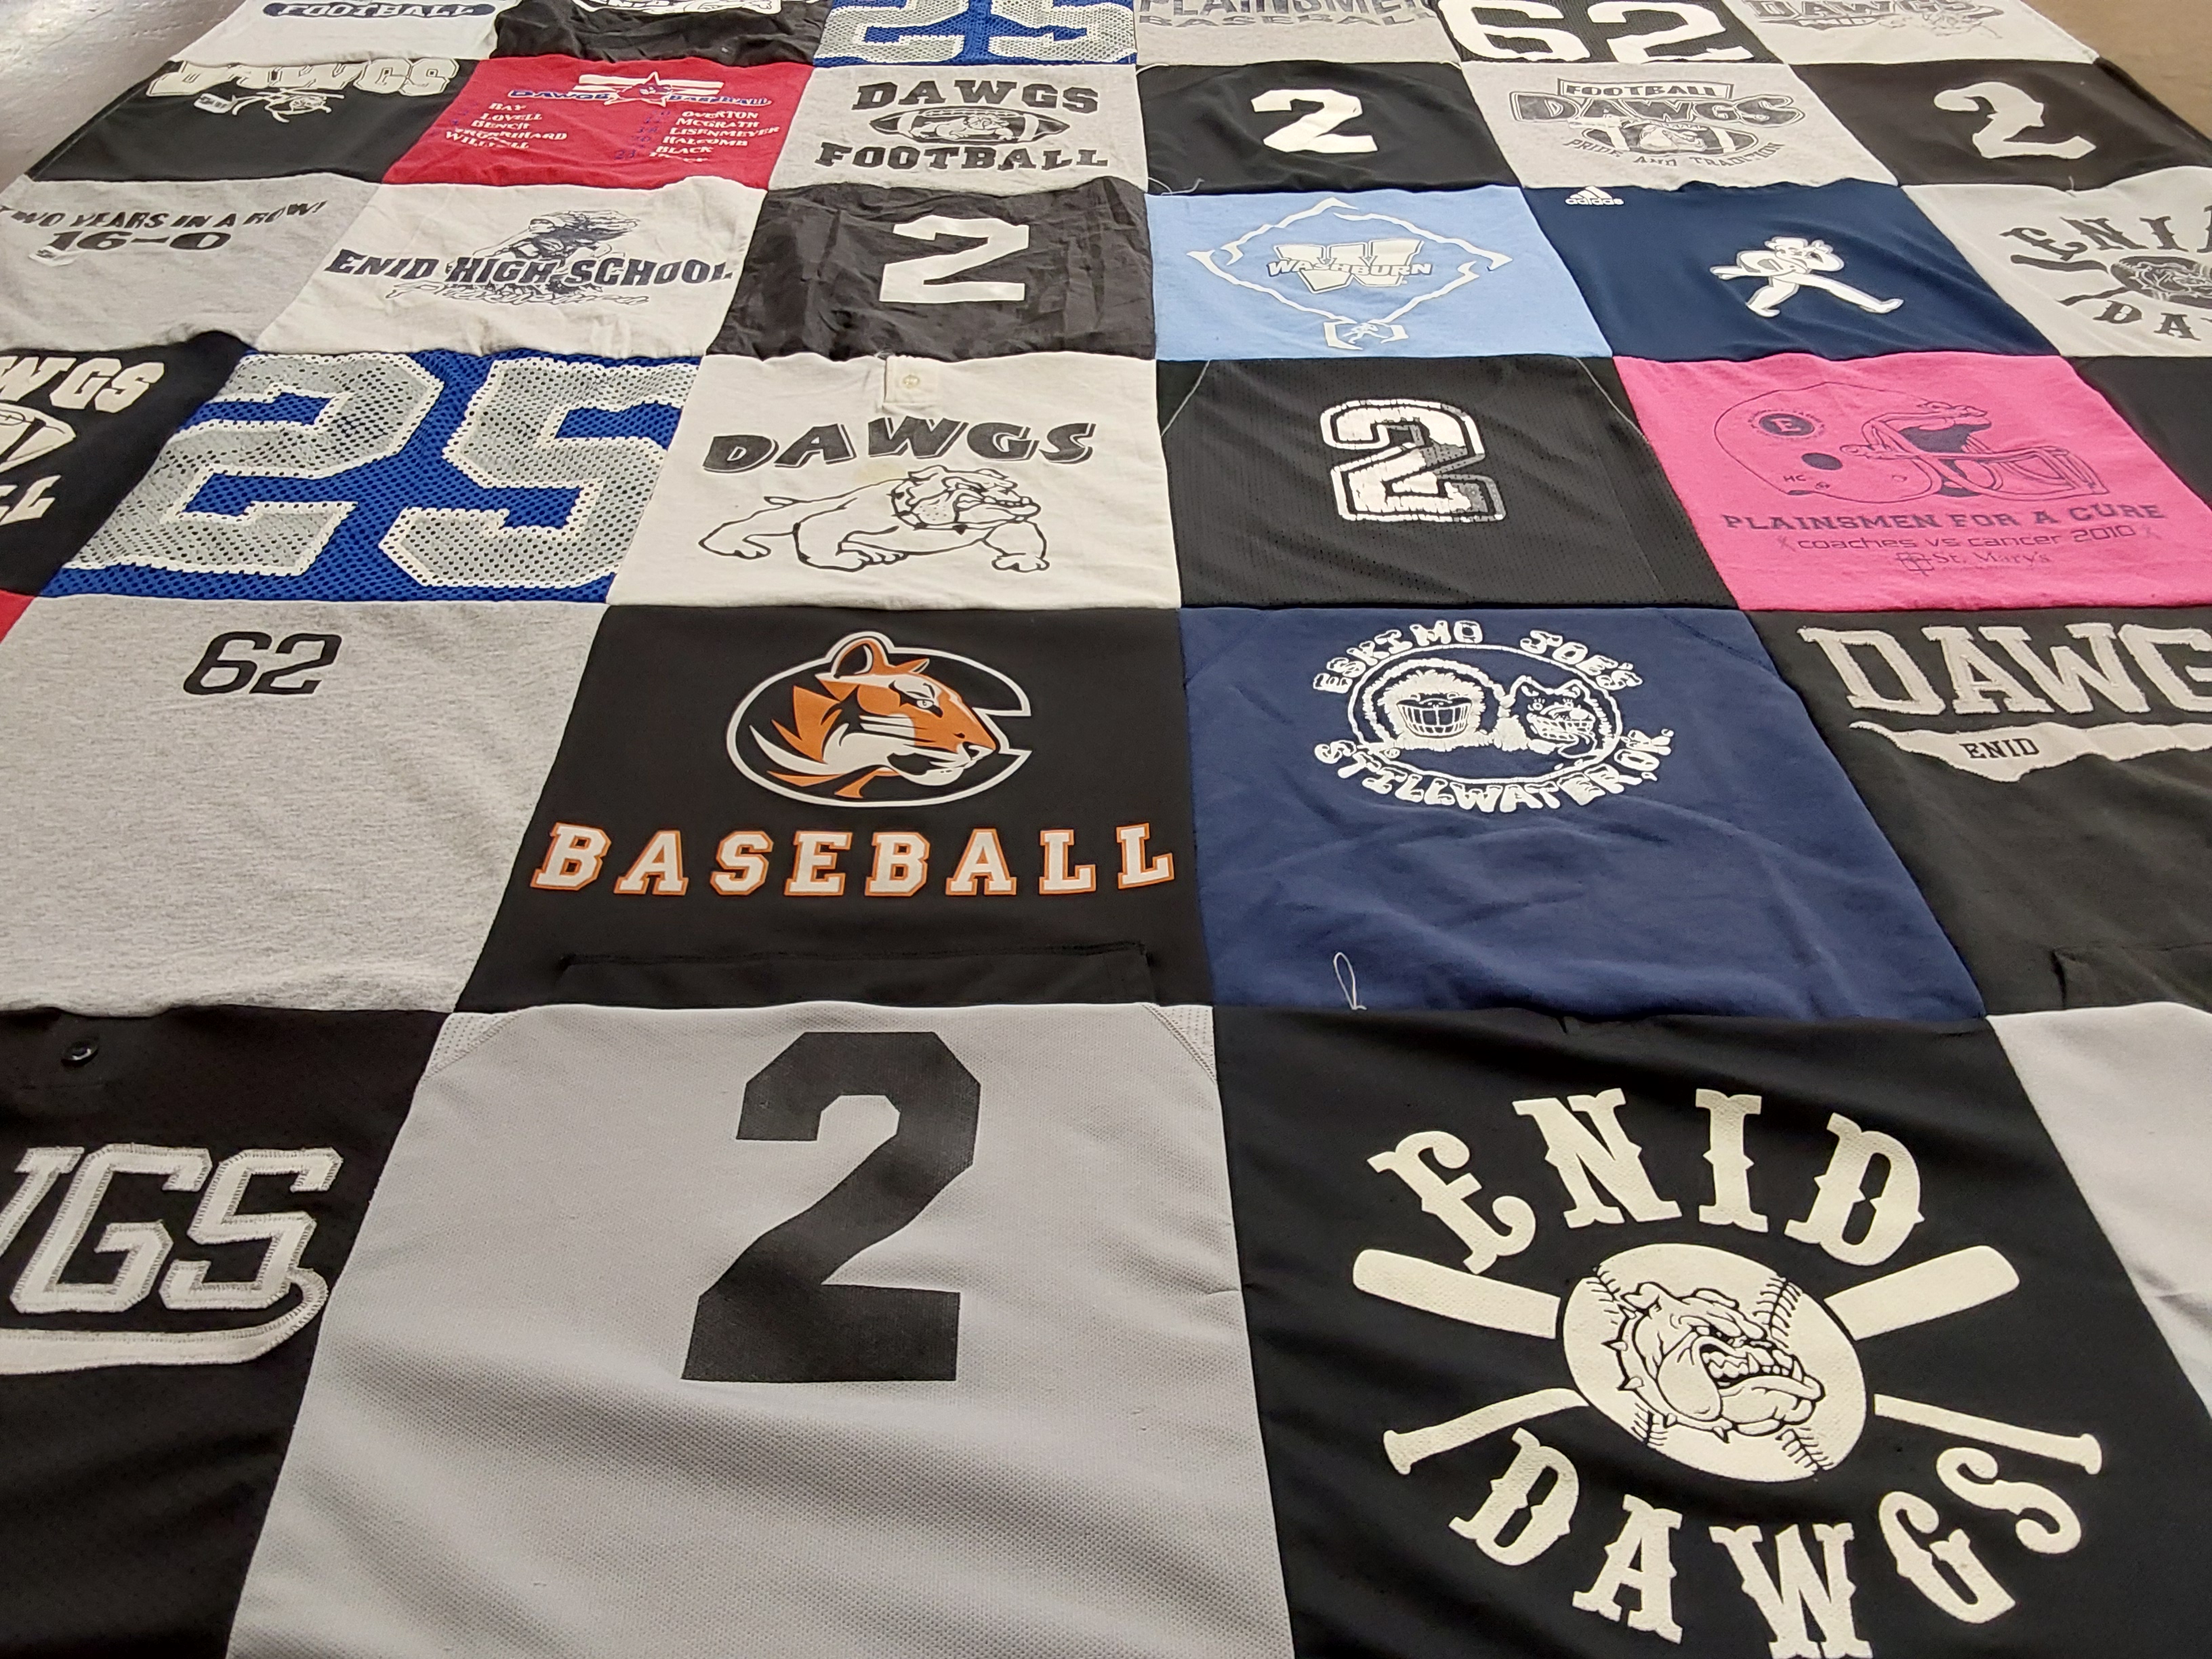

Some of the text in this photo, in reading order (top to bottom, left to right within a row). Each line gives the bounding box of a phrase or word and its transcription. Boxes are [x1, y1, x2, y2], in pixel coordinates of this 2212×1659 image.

[276, 4, 476, 18] FOOTBALL
[1438, 0, 1754, 62] 62
[510, 89, 612, 100] DAWGS
[851, 79, 1099, 115] DAWGS
[1565, 84, 1719, 97] FOOTBALL
[479, 112, 543, 122] LOVELL
[682, 110, 758, 119] OVERTON
[1251, 88, 1379, 154] 2
[1509, 91, 1806, 127] DAWGS
[1933, 81, 2097, 161] 2
[655, 146, 714, 155] BLACK
[815, 142, 1109, 171] FOOTBALL
[1562, 139, 1624, 158] PRIDE
[1689, 141, 1787, 167] TRADITION
[69, 211, 170, 229] YEARS
[169, 213, 213, 228] IN
[213, 213, 237, 228] A
[243, 201, 329, 226] ROW!
[1564, 194, 1624, 205] adidas
[46, 230, 232, 251] 16-0
[1999, 205, 2212, 262] ENI
[324, 248, 734, 287] ENID HIGH SCHOOL
[879, 214, 1030, 304] 2
[1265, 260, 1434, 279] WASHBURN
[701, 415, 1098, 473] DAWGS
[1319, 398, 1507, 523] 2
[61, 351, 699, 590] 25
[1722, 503, 2167, 531] PLAINSMEN FOR A CURE
[1797, 524, 2138, 550] coaches vs cancer 2010
[1933, 552, 2053, 567] St. Mary's
[182, 630, 343, 696] 62
[1311, 619, 1643, 694] ESKIMO JOE'S
[1959, 737, 2041, 760] ENID
[530, 821, 1176, 897] BASEBALL
[1367, 1087, 1926, 1275] ENID
[680, 1031, 982, 1384] 2
[1448, 1426, 2083, 1659] DAWGS
